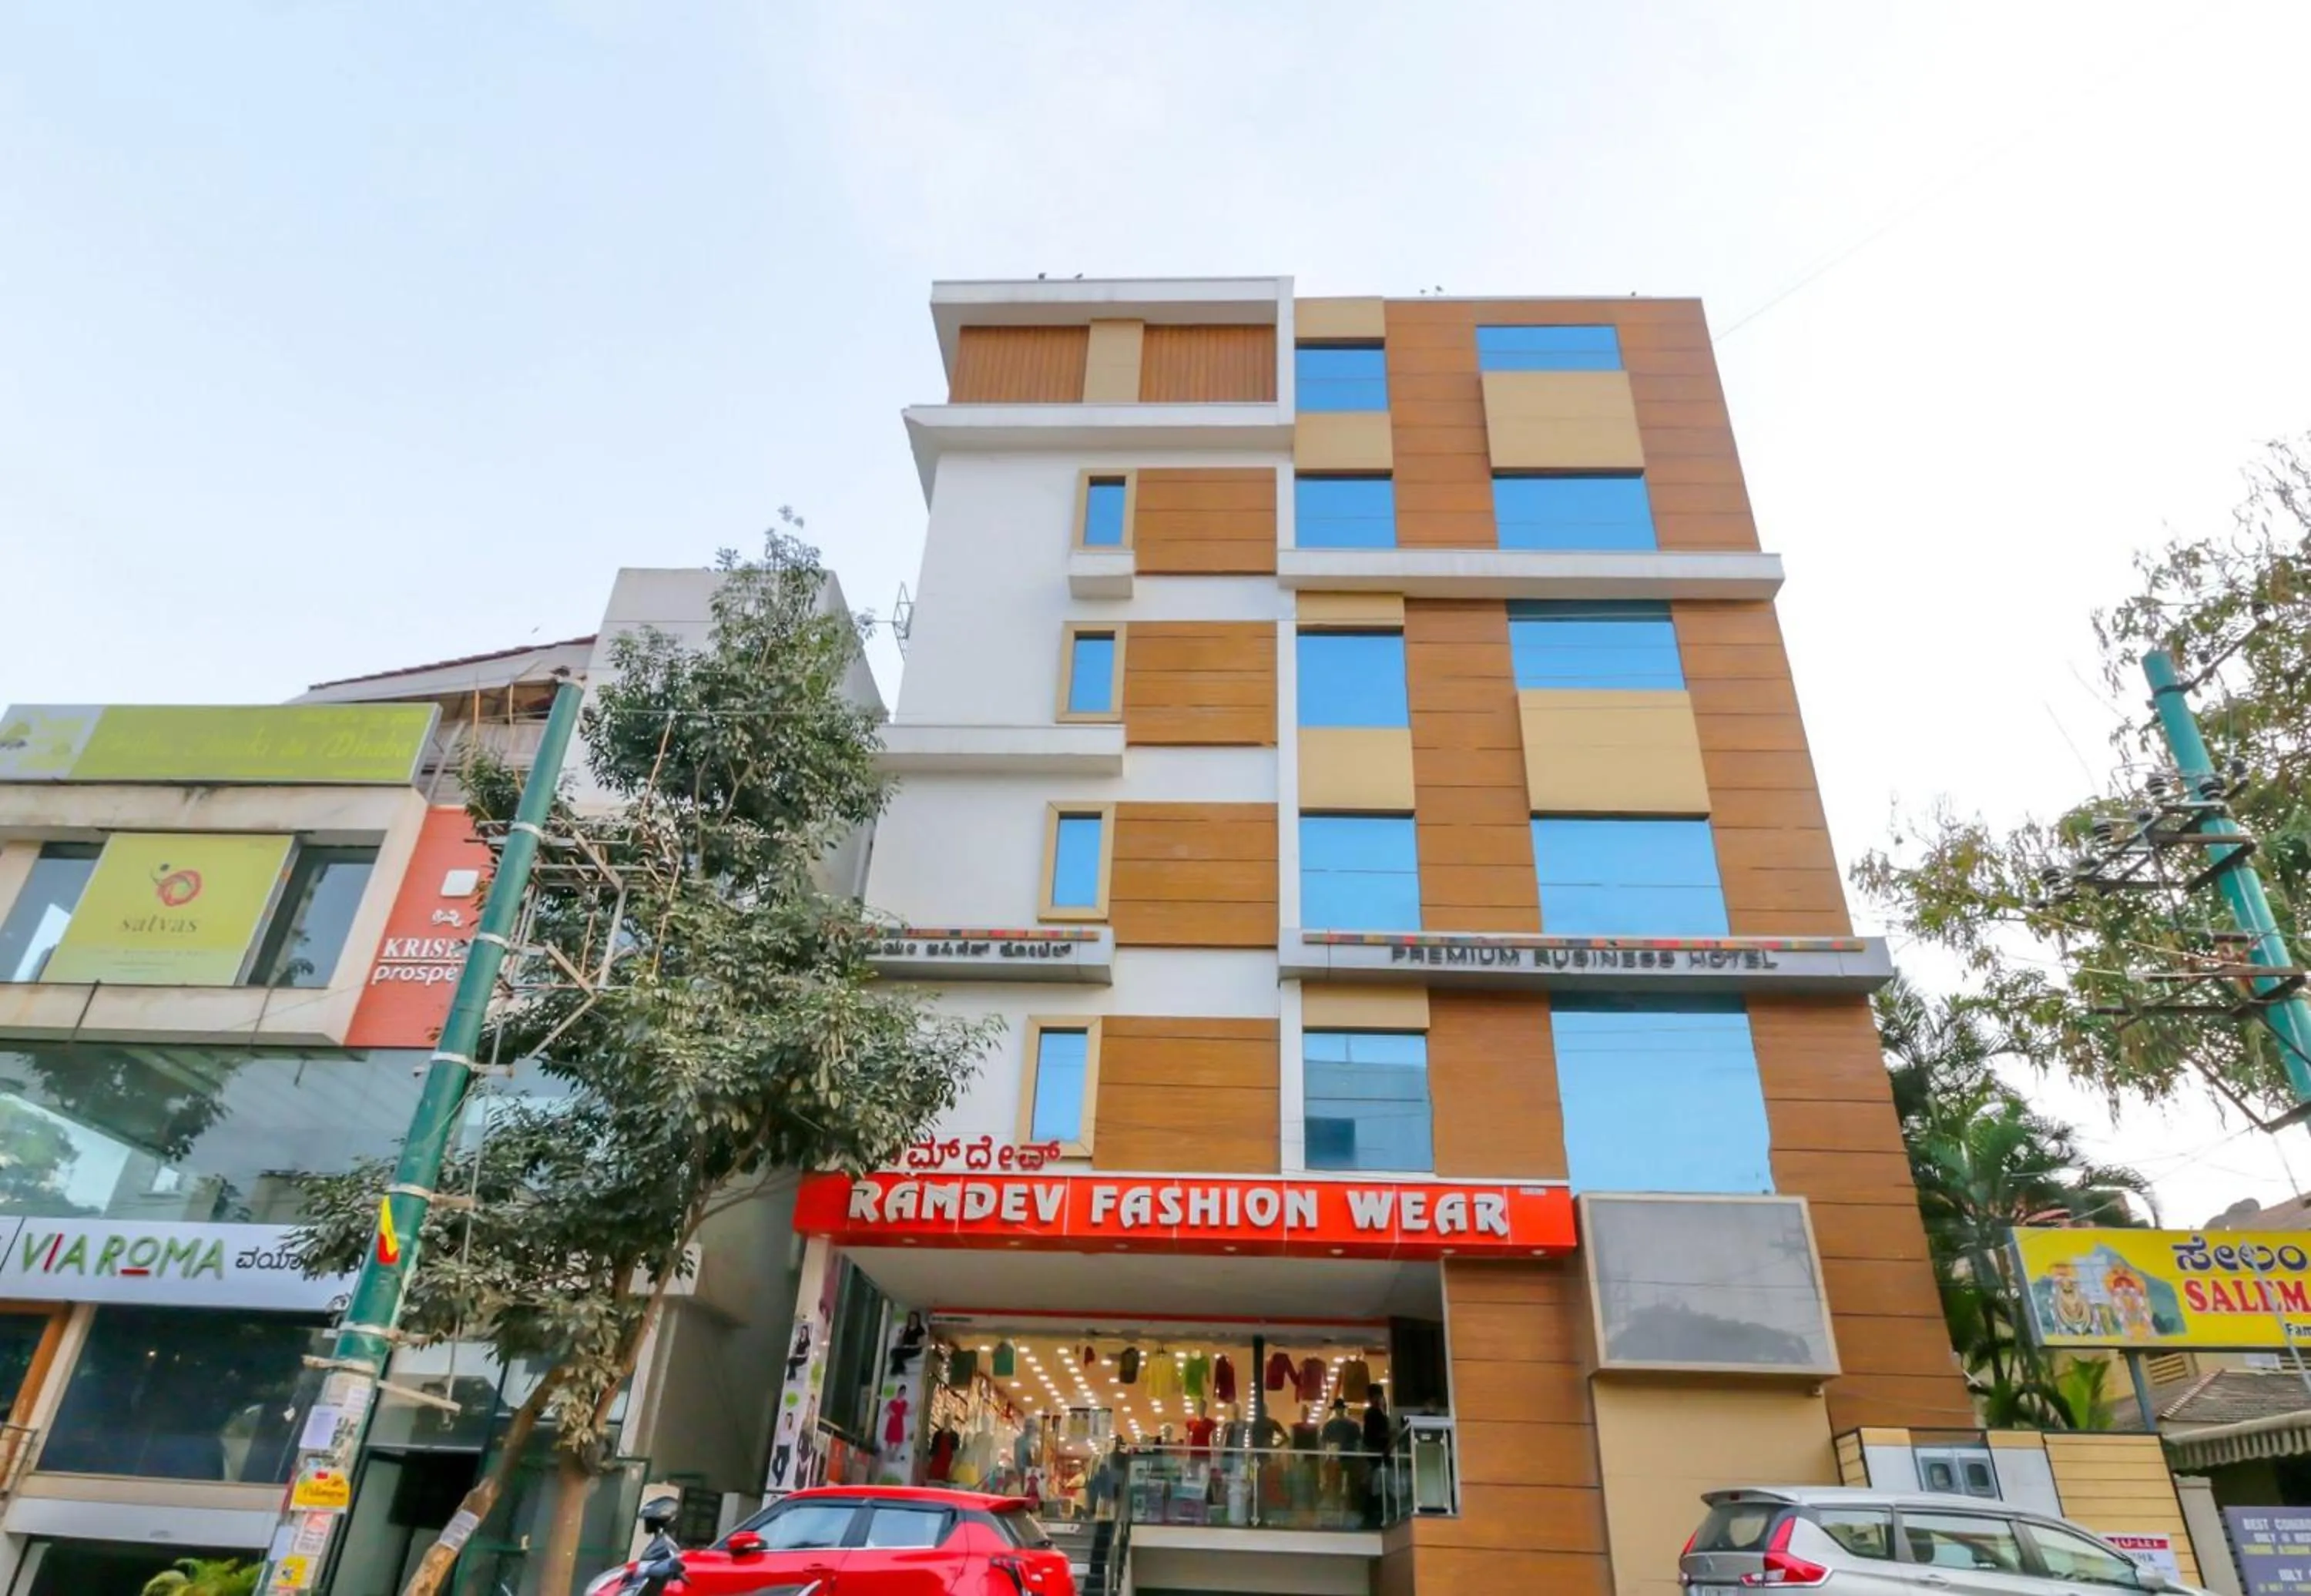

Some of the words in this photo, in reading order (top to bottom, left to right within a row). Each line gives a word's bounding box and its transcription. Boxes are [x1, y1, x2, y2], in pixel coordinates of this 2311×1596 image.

[1391, 946, 1520, 966] PREMIUM
[1534, 947, 1675, 970] BUSINESS
[1688, 948, 1779, 970] HOTEL
[848, 1179, 1066, 1224] RAMDEV
[1090, 1184, 1318, 1229] FASHION
[1347, 1190, 1511, 1238] WEAR
[22, 1232, 87, 1275] VIA
[94, 1234, 225, 1279] ROMA
